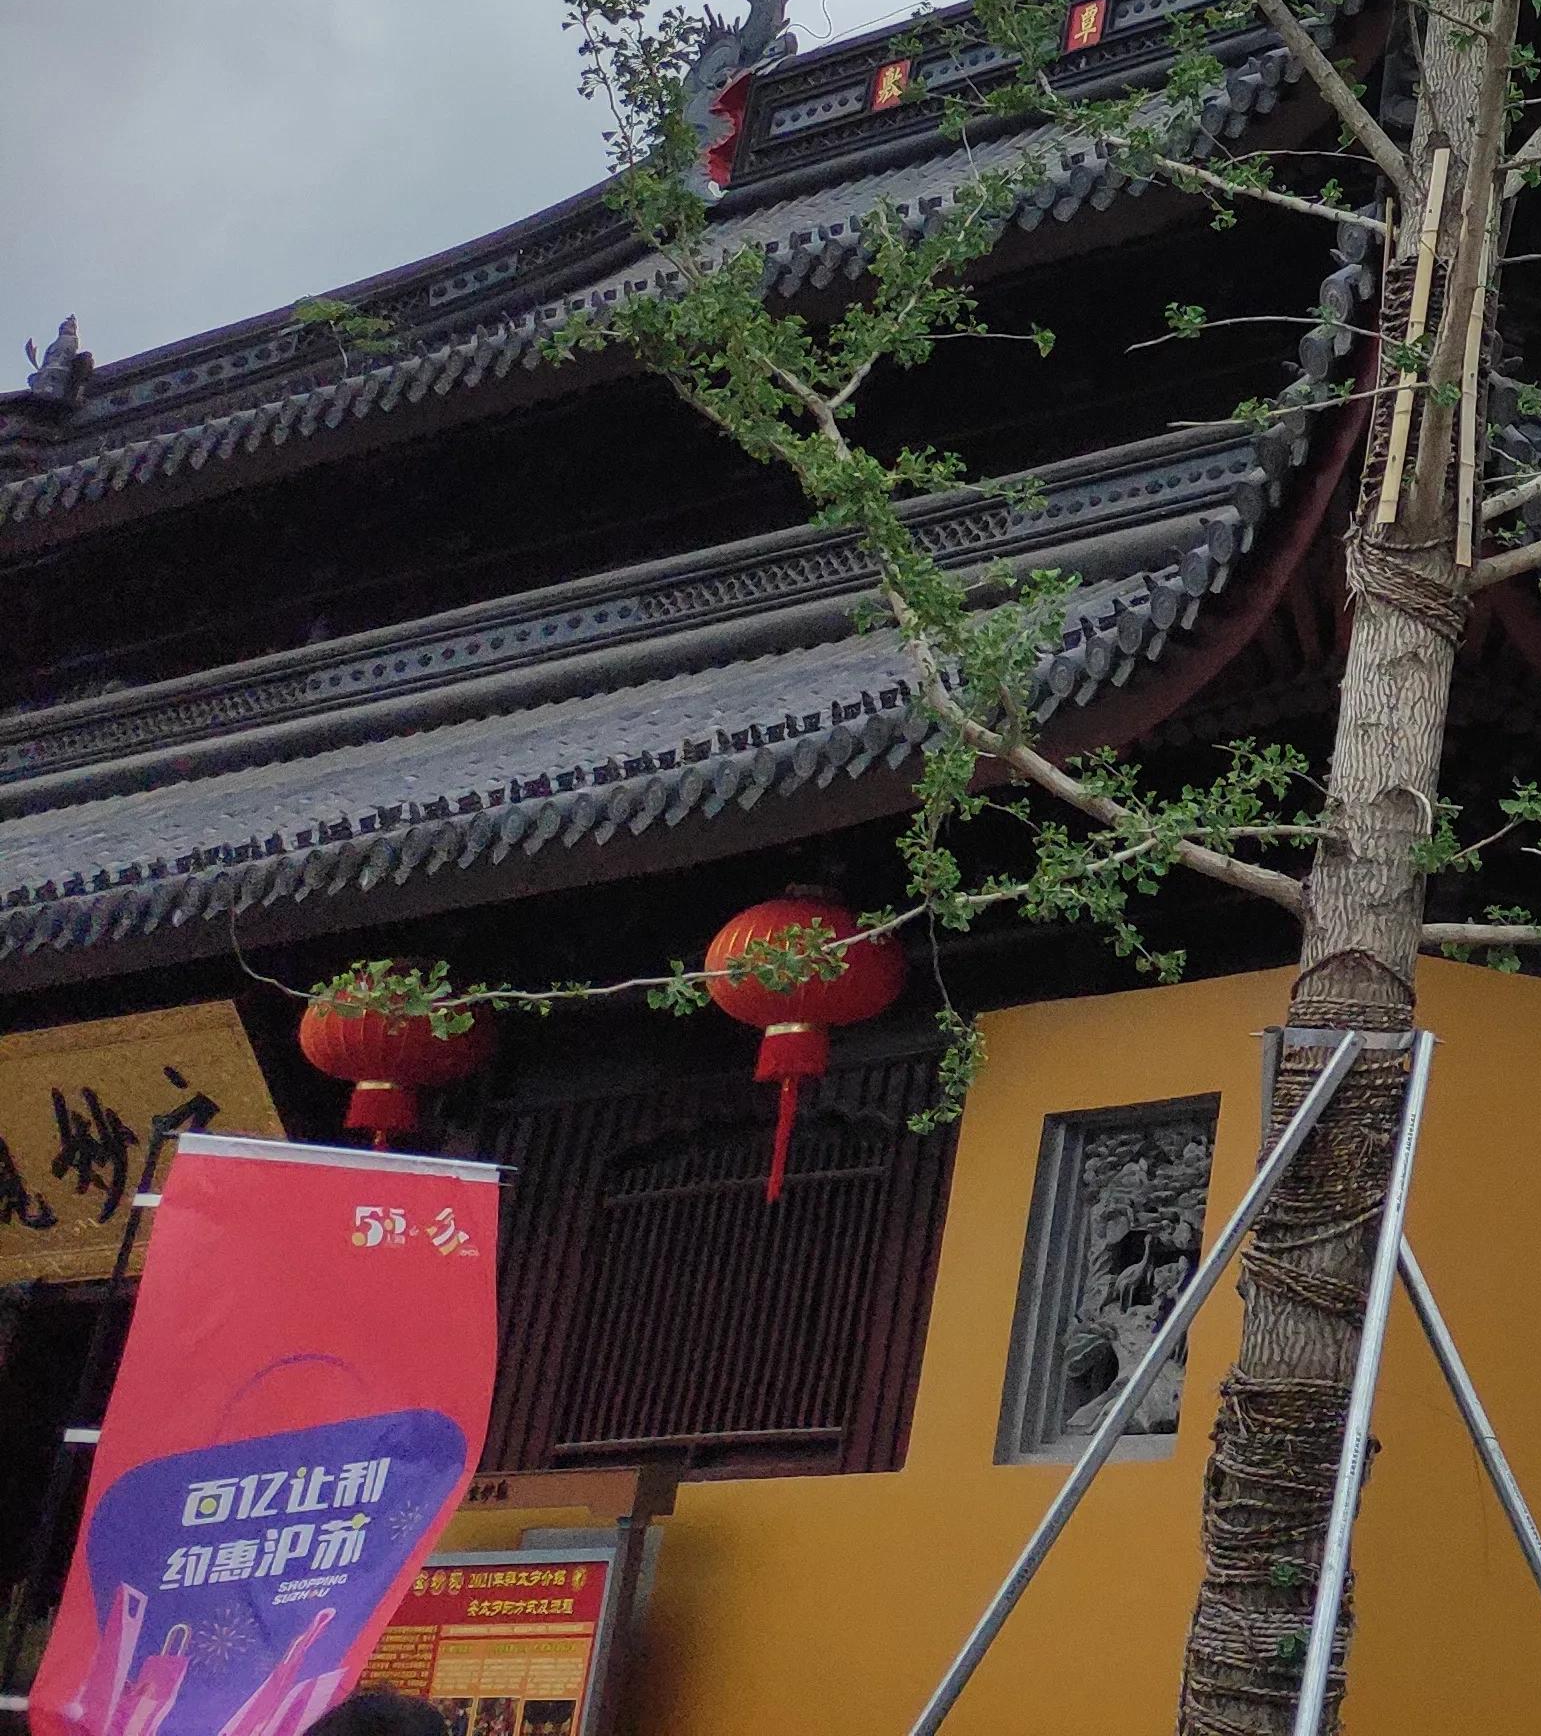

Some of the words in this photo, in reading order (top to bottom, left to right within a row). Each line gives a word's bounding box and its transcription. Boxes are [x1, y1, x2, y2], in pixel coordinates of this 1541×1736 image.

[181, 1456, 392, 1527] 百亿让利
[159, 1512, 371, 1591] 约惠沪苏
[278, 1573, 348, 1594] SHOPPING
